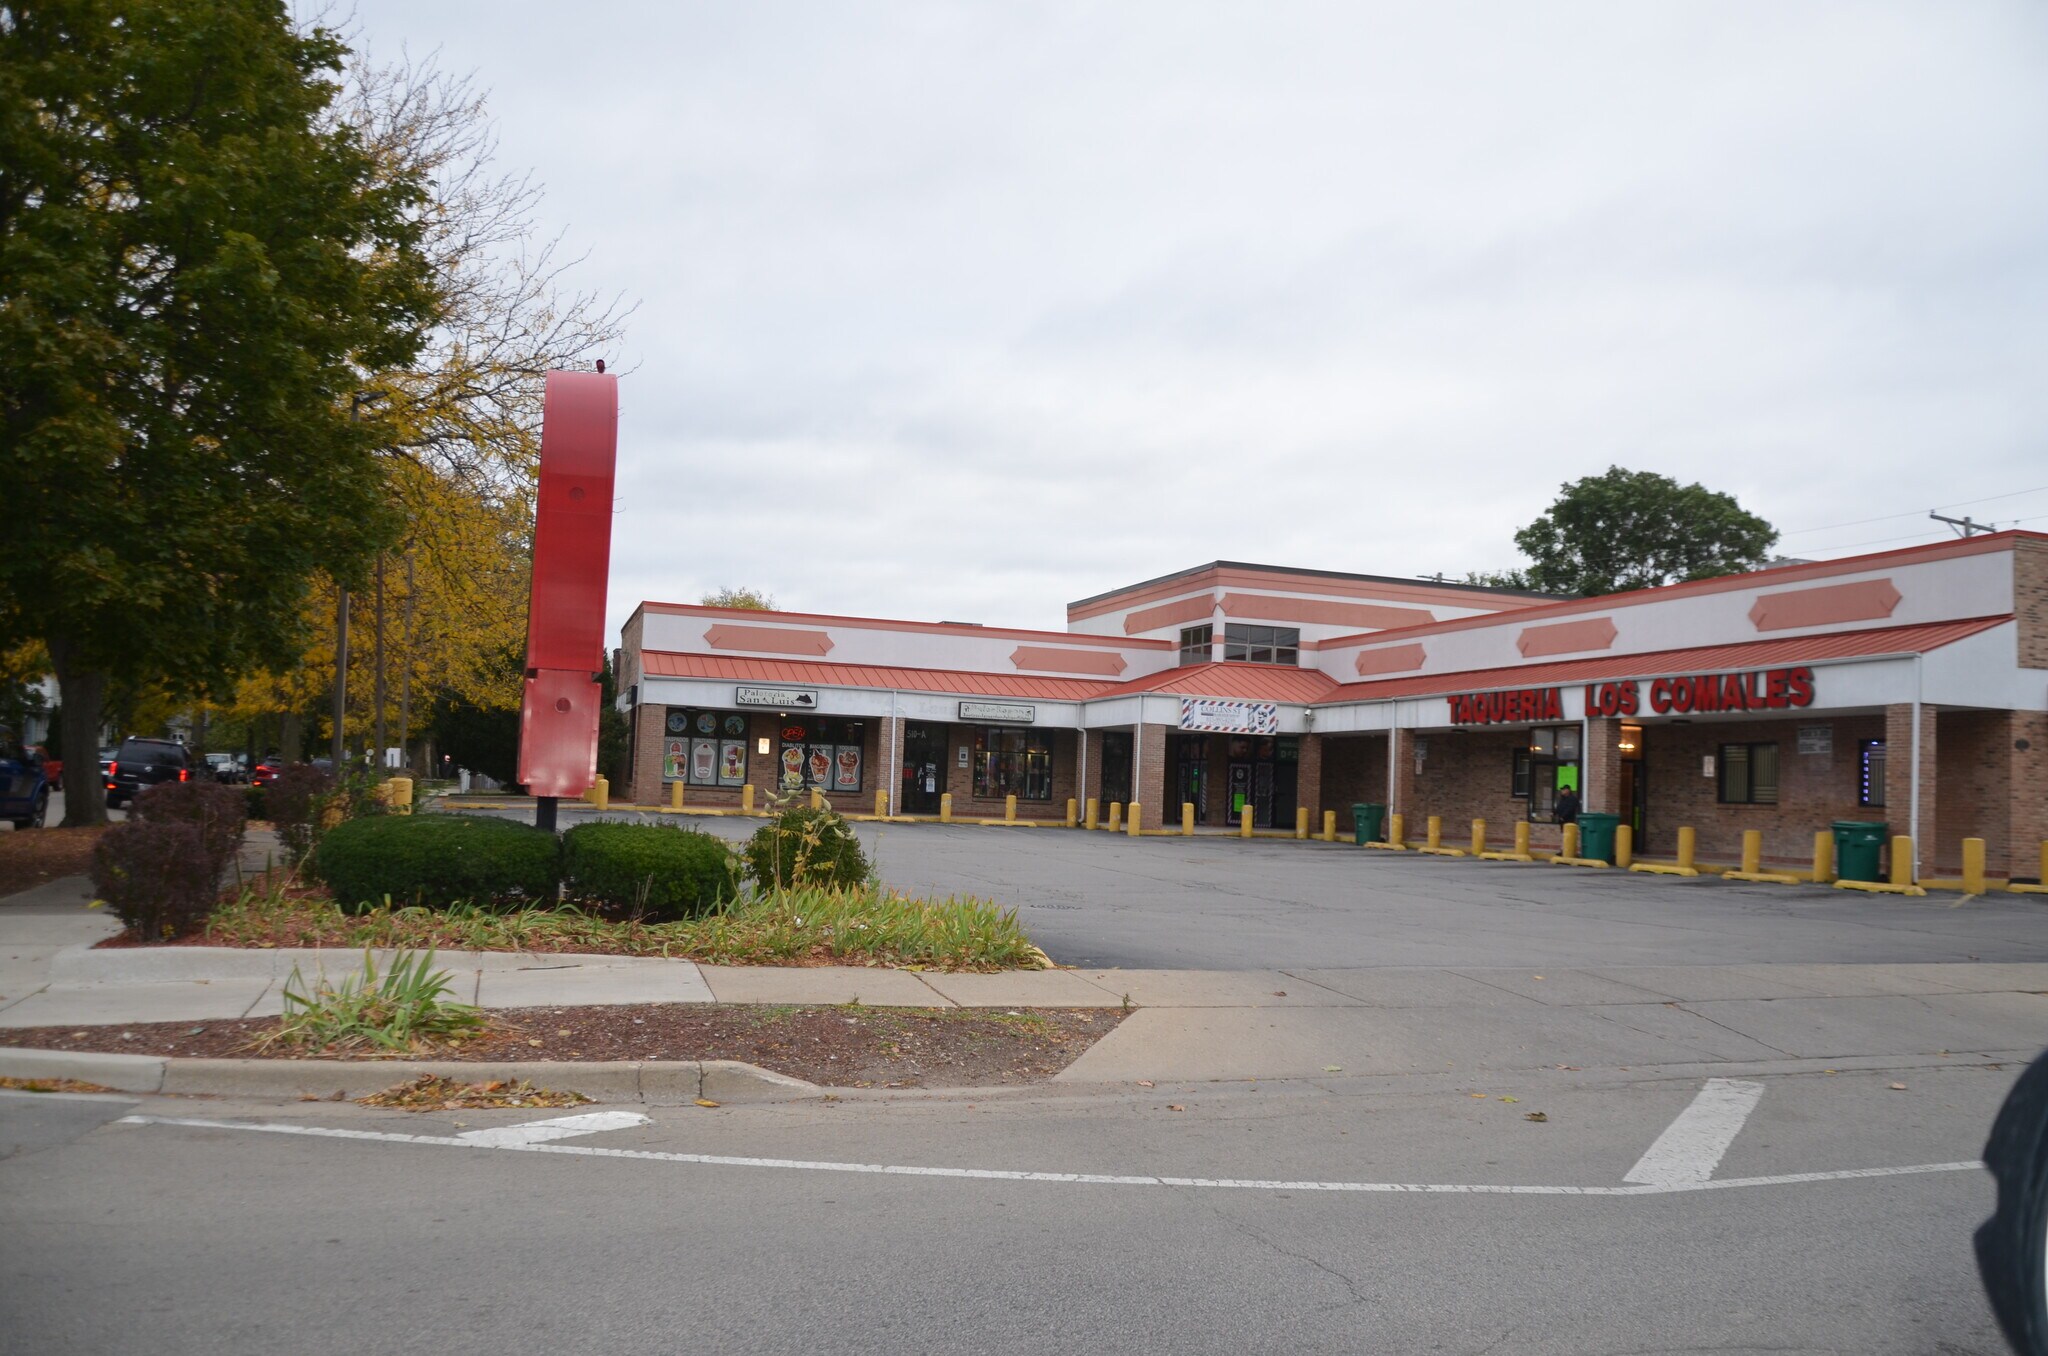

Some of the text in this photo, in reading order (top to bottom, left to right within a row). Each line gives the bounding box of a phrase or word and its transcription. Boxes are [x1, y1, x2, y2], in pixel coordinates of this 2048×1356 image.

[739, 695, 795, 705] San Luis
[1447, 666, 1815, 725] TAQUERIA LOS COMALES
[781, 726, 806, 739] OPEN
